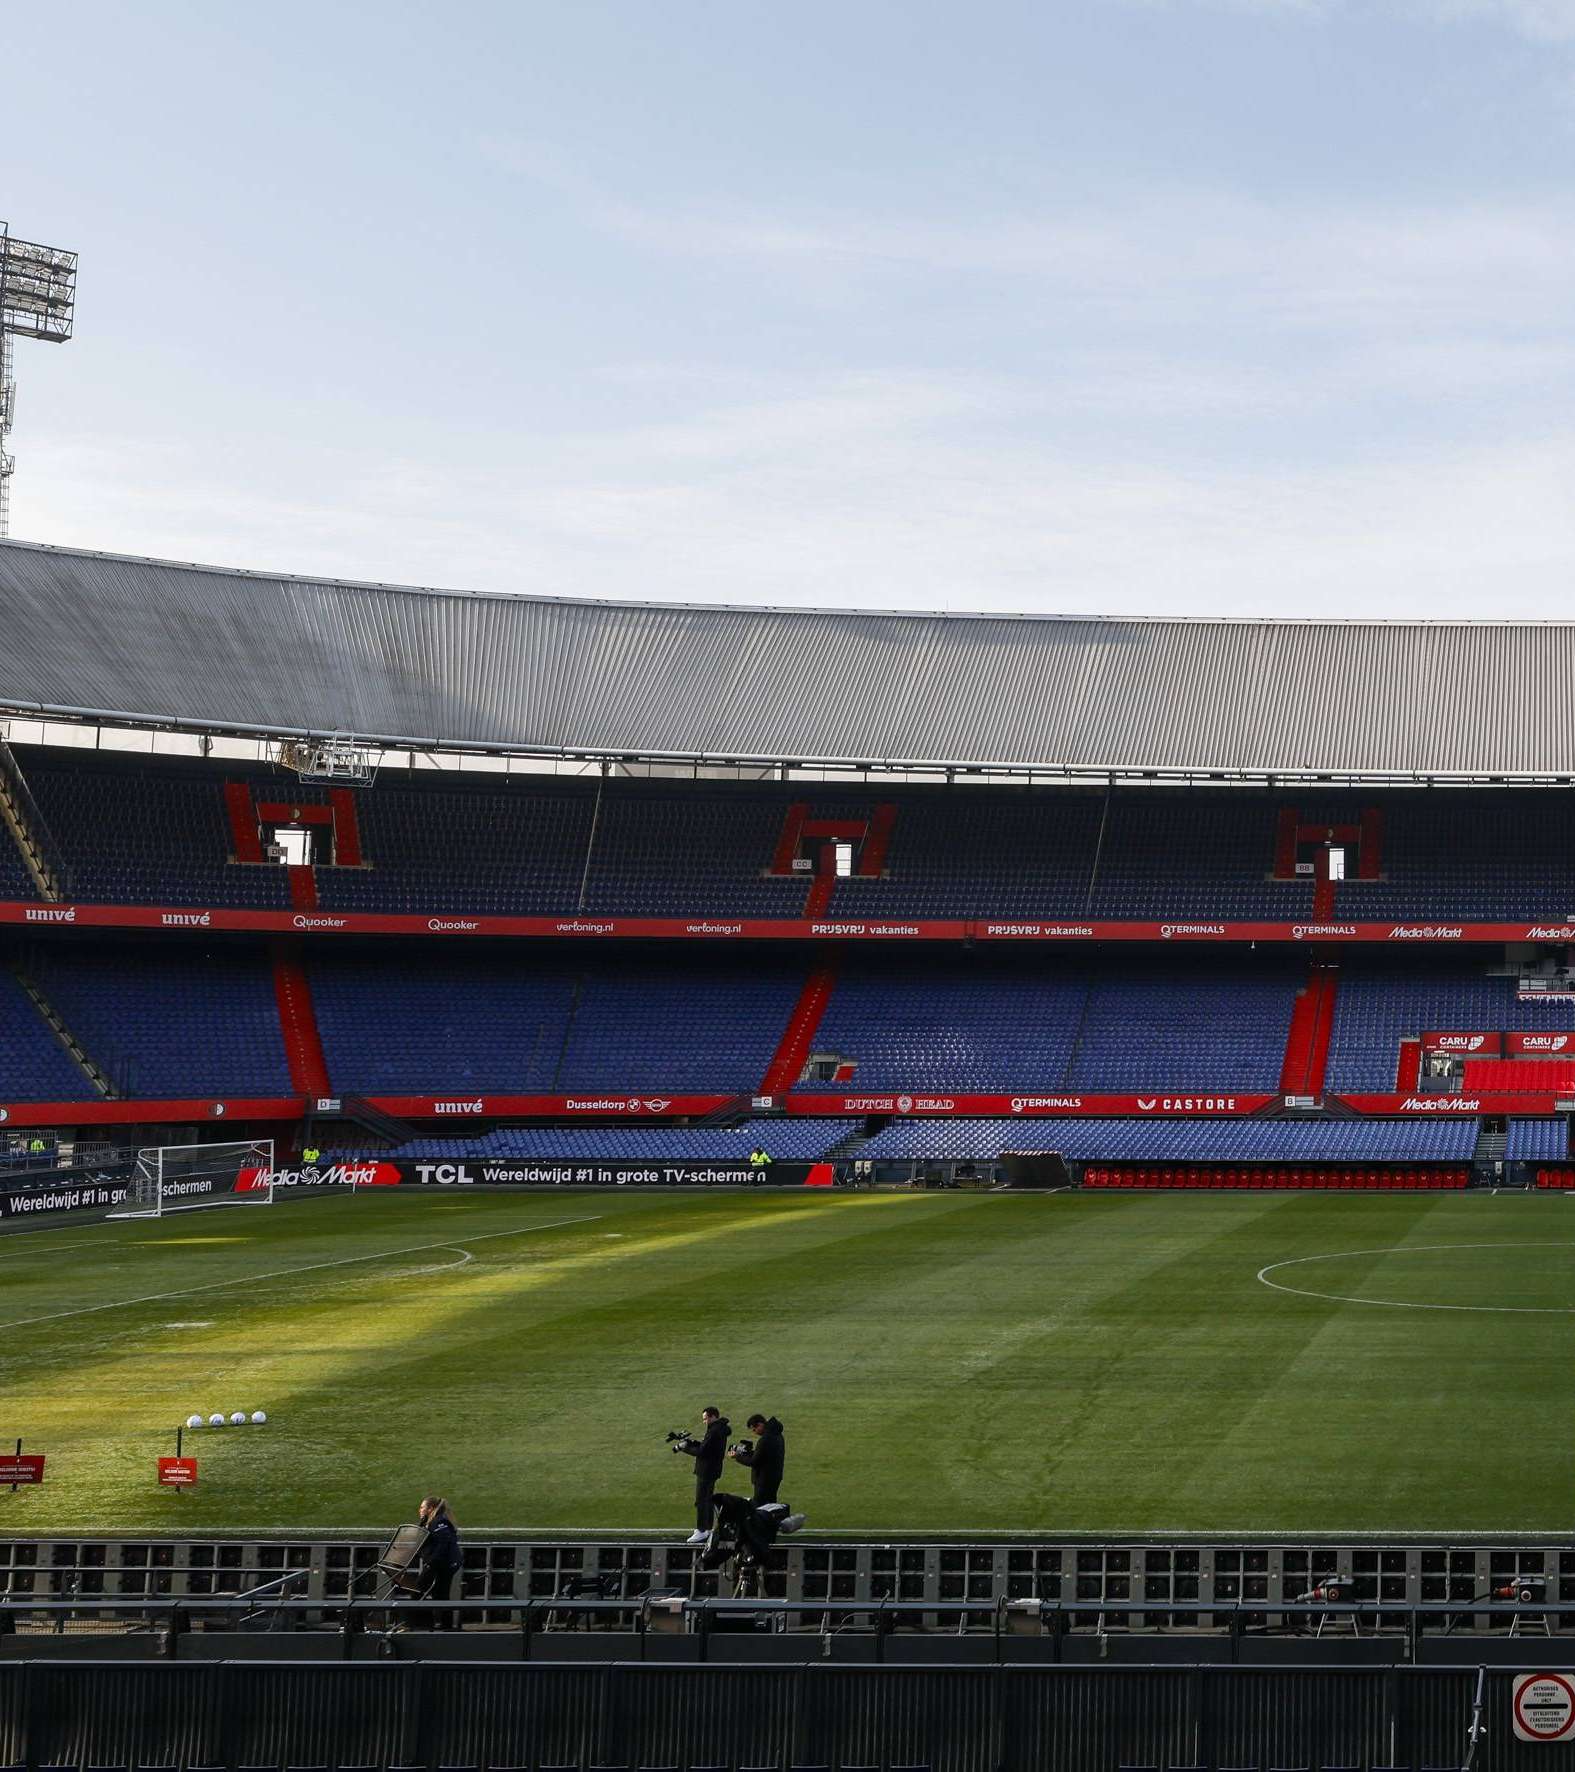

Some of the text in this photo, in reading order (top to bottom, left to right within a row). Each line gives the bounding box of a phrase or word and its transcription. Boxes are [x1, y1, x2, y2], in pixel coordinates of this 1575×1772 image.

[26, 907, 75, 921] univé
[162, 912, 210, 925] univé
[293, 915, 346, 928] Quooker
[428, 918, 478, 930] Quooker
[870, 925, 919, 934] vakanties
[1045, 926, 1092, 935] vakanties
[1161, 925, 1225, 938] QTERMINALS
[1293, 925, 1356, 938] QTERMINALS
[1389, 927, 1462, 938] Media Markt
[1526, 927, 1560, 938] Media
[1440, 1037, 1467, 1046] CARU
[1523, 1037, 1550, 1046] CARU
[435, 1099, 483, 1113] univé
[567, 1100, 625, 1111] Dusseldorp
[845, 1099, 954, 1110] DUTCH HEAD
[1011, 1097, 1081, 1112] QTERMINALS
[1164, 1098, 1234, 1109] CASTORE
[1400, 1098, 1480, 1111] Media Markt
[317, 1164, 376, 1185] Markt
[416, 1165, 473, 1183] TCL
[483, 1168, 571, 1184] Wereldwijd
[576, 1169, 592, 1182] #1
[598, 1168, 611, 1182] in
[617, 1170, 658, 1184] grote
[10, 1190, 79, 1212] Wereldwijd
[82, 1189, 95, 1204] #1
[98, 1189, 108, 1202] in
